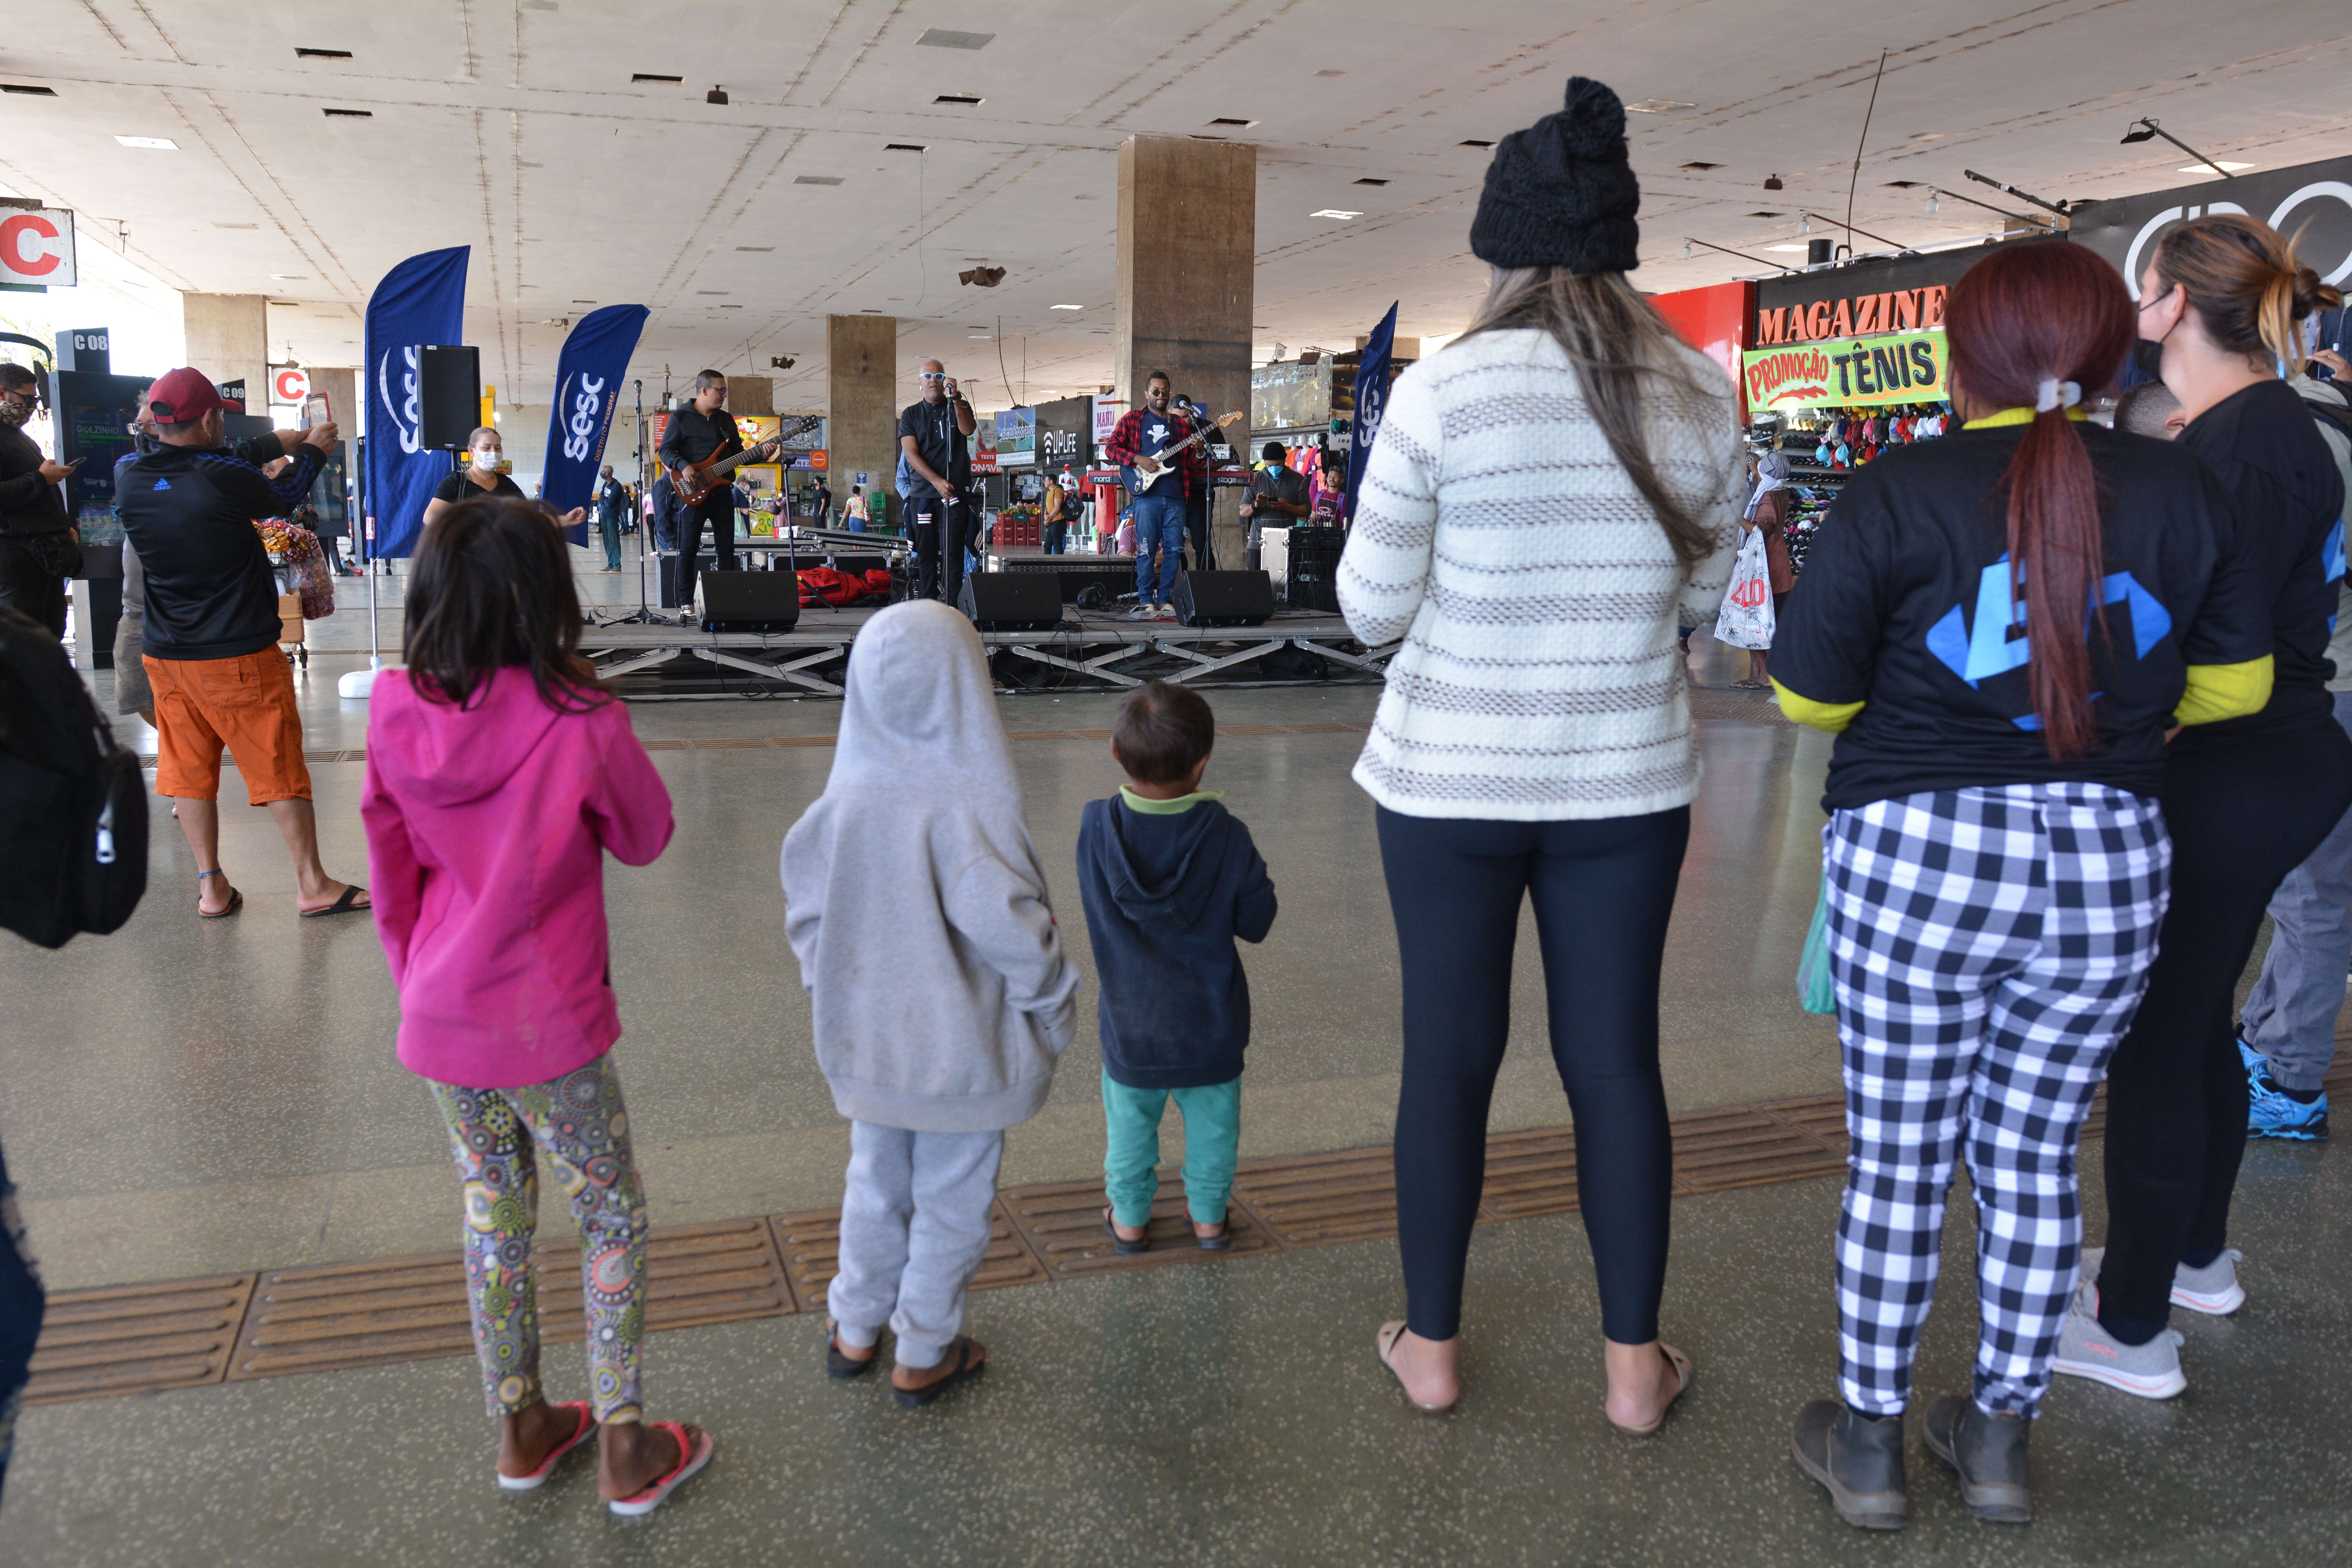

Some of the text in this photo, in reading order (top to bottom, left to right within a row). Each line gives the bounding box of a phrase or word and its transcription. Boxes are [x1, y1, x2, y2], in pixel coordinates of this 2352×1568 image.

[0, 214, 61, 276] C
[1757, 285, 1949, 345] MAGAZINE
[74, 335, 108, 350] C 08
[223, 387, 245, 399] C 09
[277, 371, 305, 399] C
[1747, 340, 1937, 403] PROMOÇÃO TÊNIS
[594, 390, 617, 461] DISTRITO FEDERAL
[1002, 425, 1036, 440] SACOLÃO DO POVO
